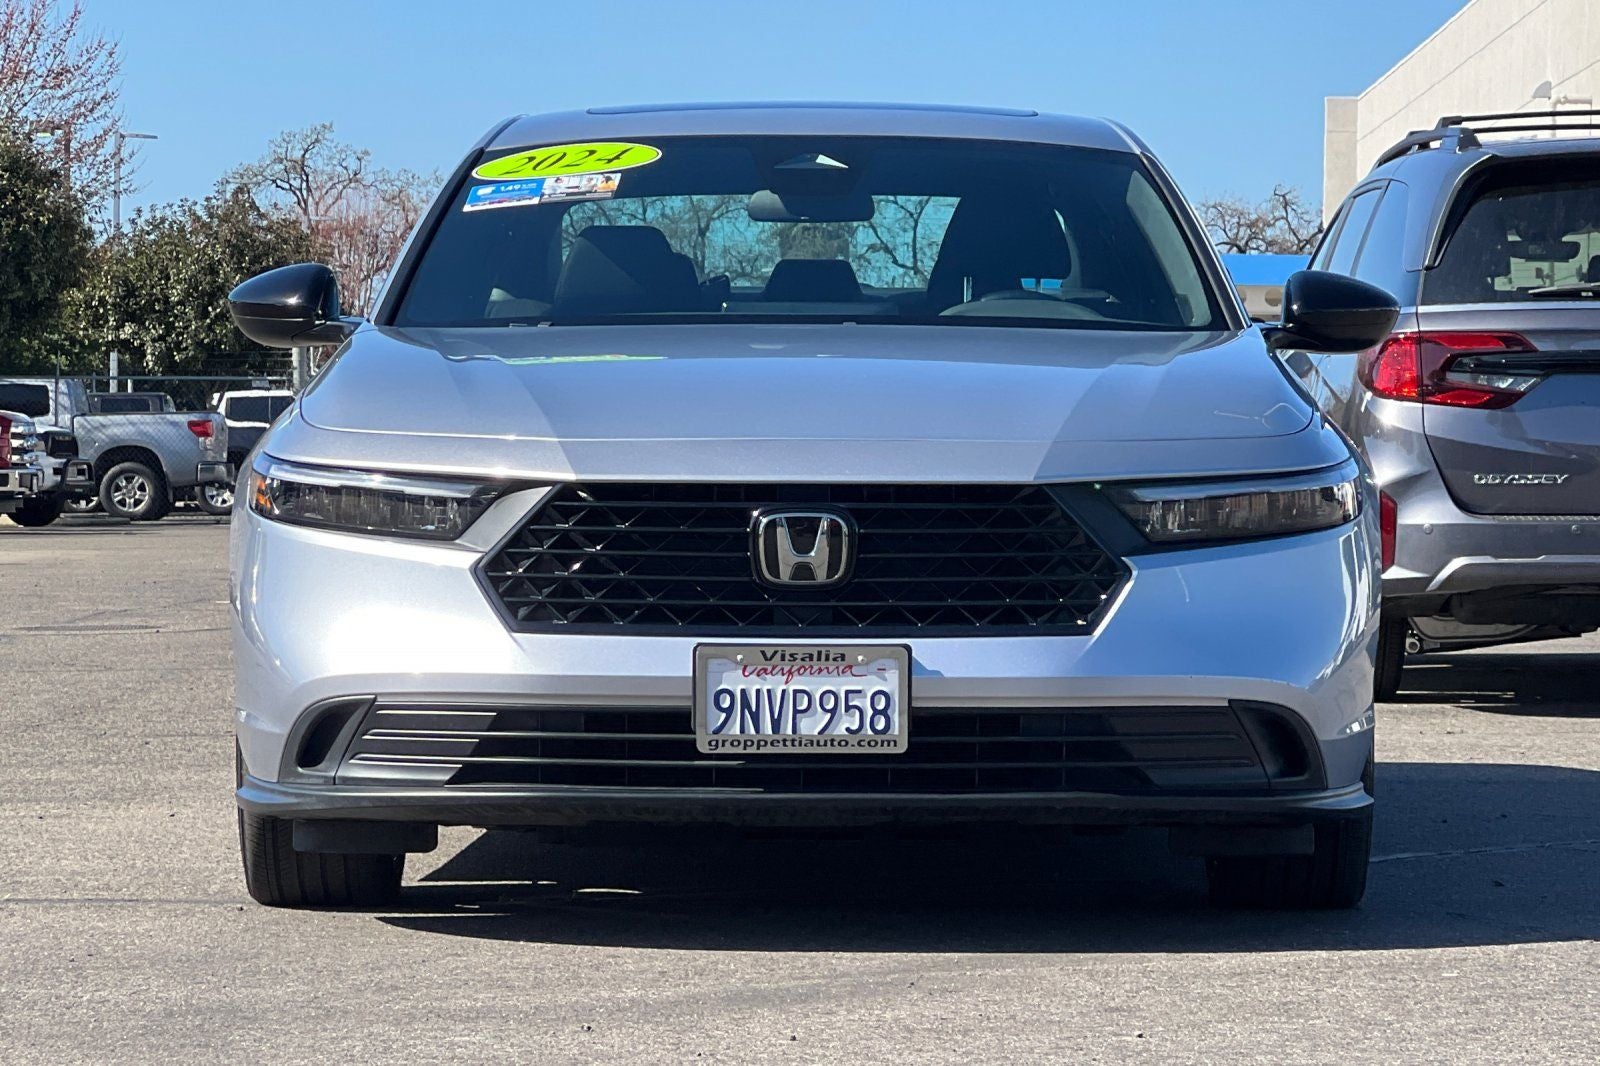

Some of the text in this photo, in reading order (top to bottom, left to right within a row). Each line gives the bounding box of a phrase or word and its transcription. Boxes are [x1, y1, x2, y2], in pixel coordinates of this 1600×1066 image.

[498, 147, 635, 176] 2024
[1473, 474, 1570, 484] ODYSSEY
[759, 649, 846, 662] Visalia
[741, 664, 868, 685] California
[711, 688, 891, 735] 9NVP958
[707, 736, 898, 751] groppettiauto.com
